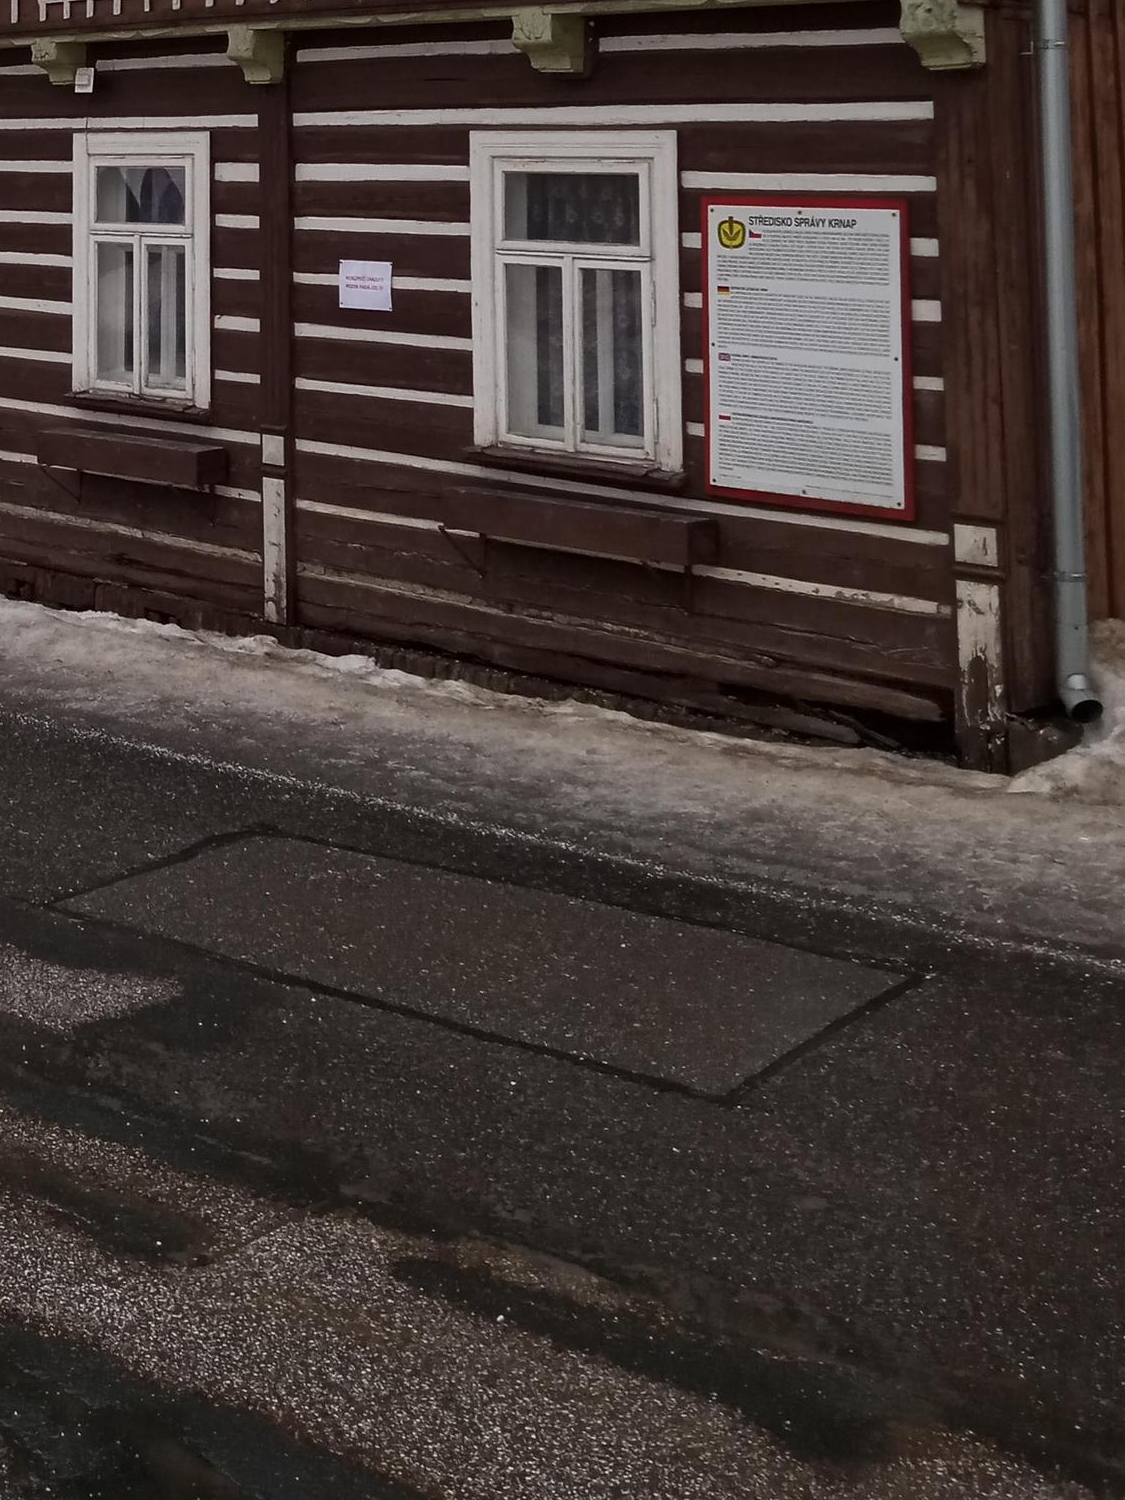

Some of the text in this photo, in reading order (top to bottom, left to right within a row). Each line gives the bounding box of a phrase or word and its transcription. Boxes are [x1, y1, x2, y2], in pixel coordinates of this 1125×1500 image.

[748, 214, 857, 229] STŘEDISKO SPRÁVY KRNAP
